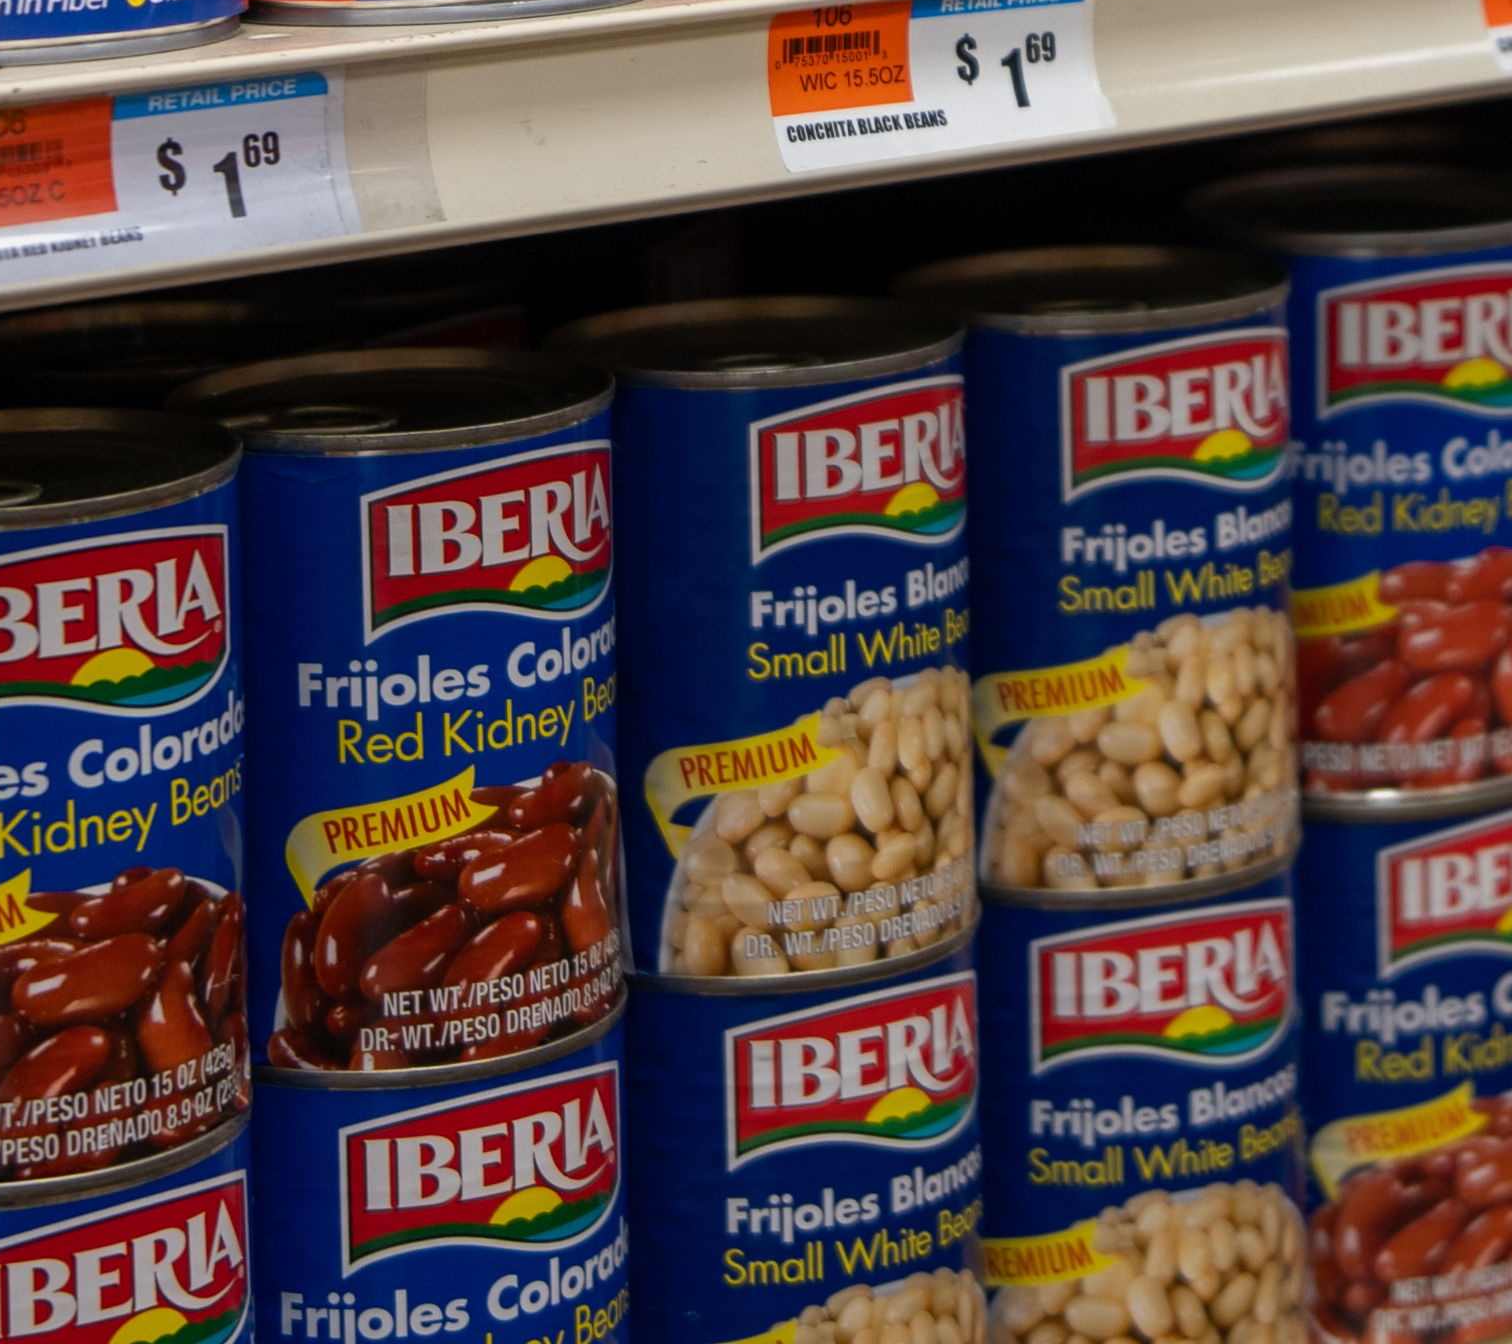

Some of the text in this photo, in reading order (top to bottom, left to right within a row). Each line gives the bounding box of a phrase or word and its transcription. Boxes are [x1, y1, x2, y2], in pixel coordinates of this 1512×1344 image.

[813, 5, 853, 28] 106
[799, 64, 906, 92] WIC 15.5OZ
[955, 33, 980, 86] $
[148, 79, 296, 113] RETAIL PRICE
[786, 109, 948, 144] CONCHITA BLACK BEANS
[383, 462, 611, 580] IBERIA
[1318, 484, 1500, 536] Red Kidney
[1058, 561, 1247, 613] Small White
[747, 614, 941, 681] Small White
[997, 663, 1126, 716] PREMIUM
[337, 693, 575, 765] Red Kidney
[678, 733, 818, 790] PREMIUM
[322, 788, 473, 858] PREMIUM
[383, 990, 423, 1017] NET
[529, 959, 570, 993] NETO
[507, 988, 581, 1034] DRENADO
[1356, 1035, 1437, 1081] Red
[1028, 1134, 1234, 1187] Small White
[724, 1219, 935, 1287] Small White
